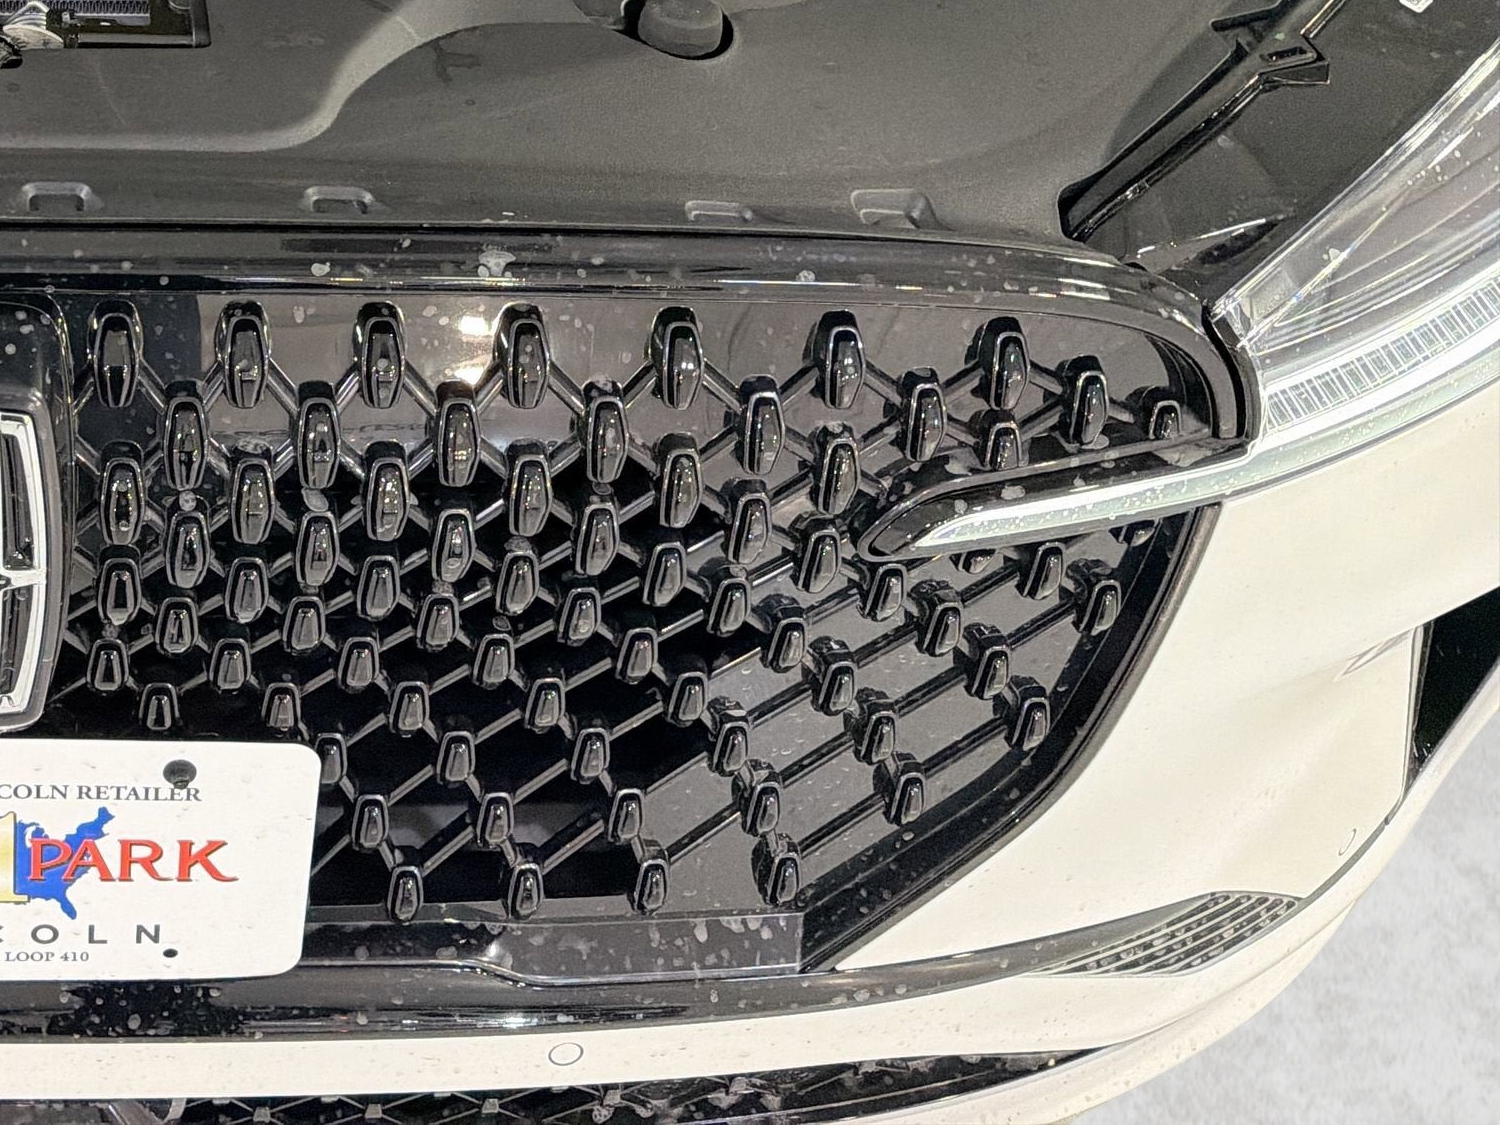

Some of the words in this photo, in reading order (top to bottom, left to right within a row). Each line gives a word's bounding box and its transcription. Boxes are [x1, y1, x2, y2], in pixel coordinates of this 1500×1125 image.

[76, 784, 202, 802] RETAILER
[27, 838, 239, 883] PARK
[4, 951, 55, 962] LOOP
[59, 951, 90, 962] 410
